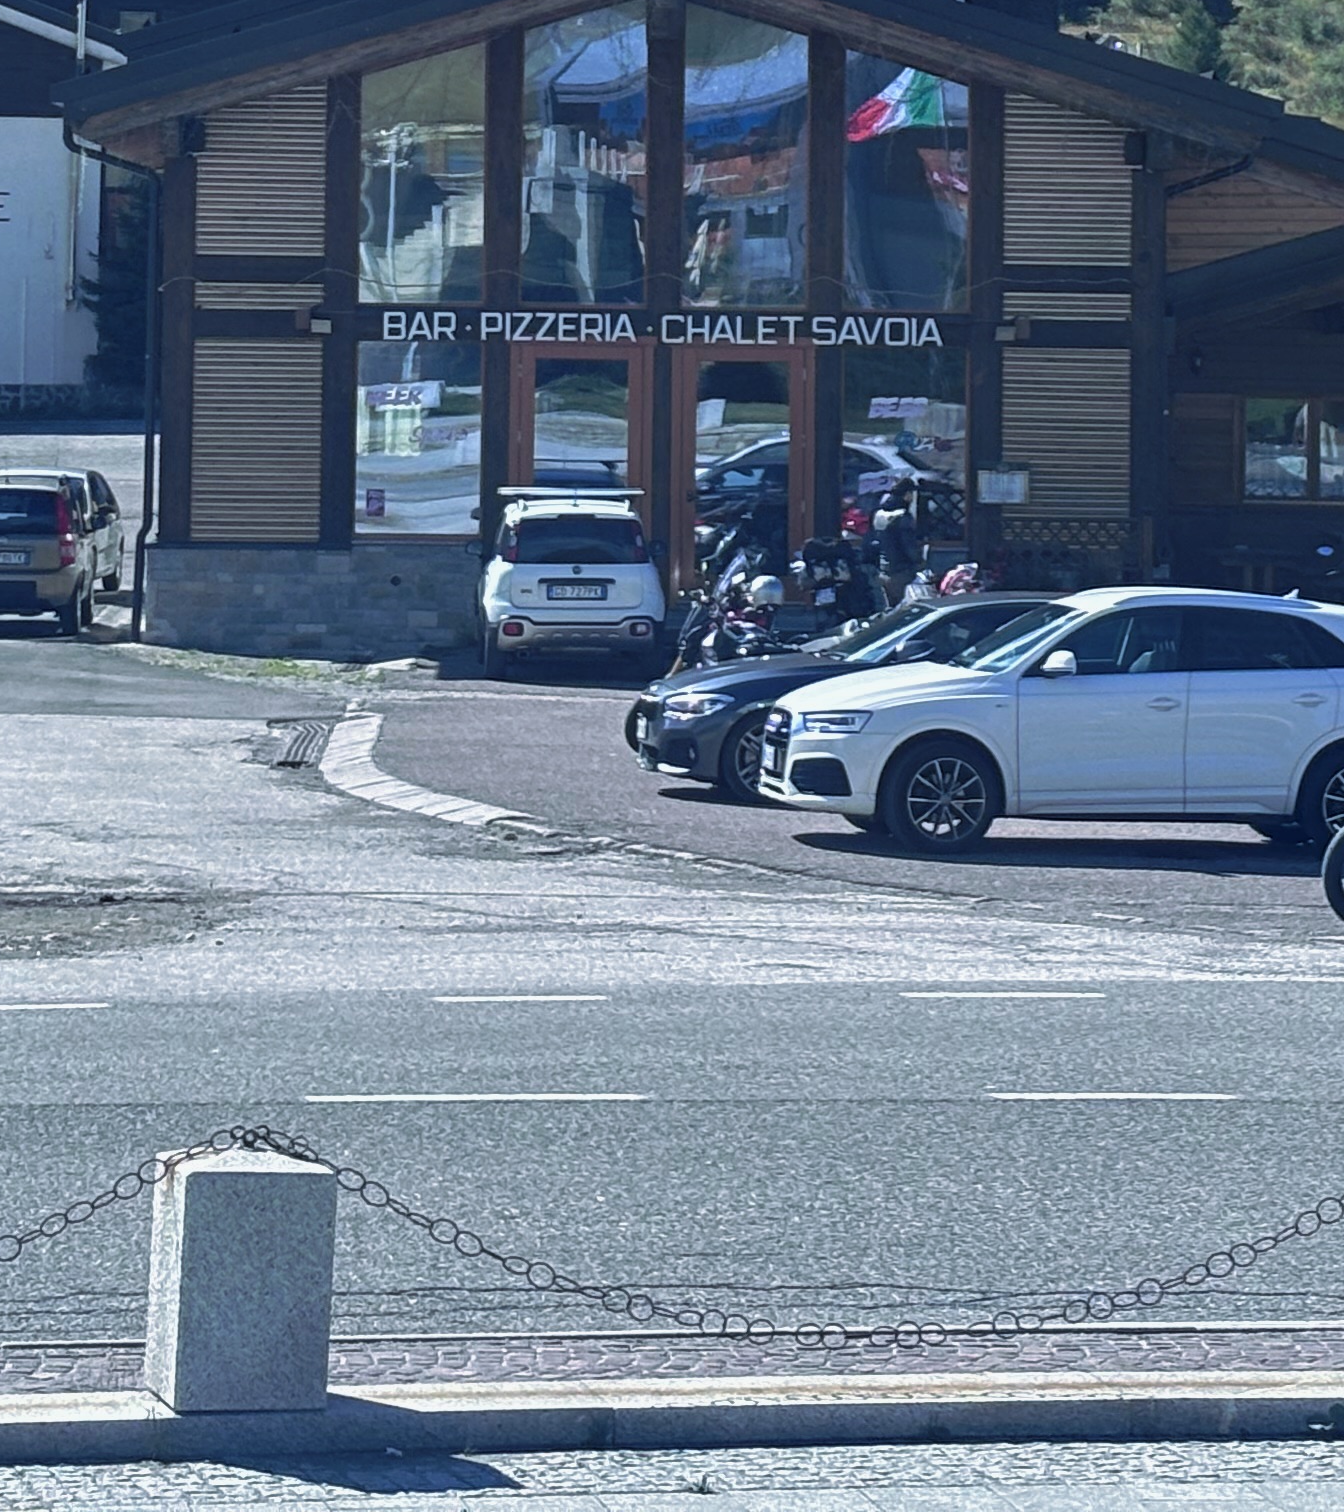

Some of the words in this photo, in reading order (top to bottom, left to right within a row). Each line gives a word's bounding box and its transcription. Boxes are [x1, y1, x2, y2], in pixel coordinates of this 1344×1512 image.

[383, 311, 456, 341] BAR
[480, 312, 637, 343] PIZZERIA
[661, 314, 804, 345] CHALET
[812, 316, 944, 347] SAVOIA
